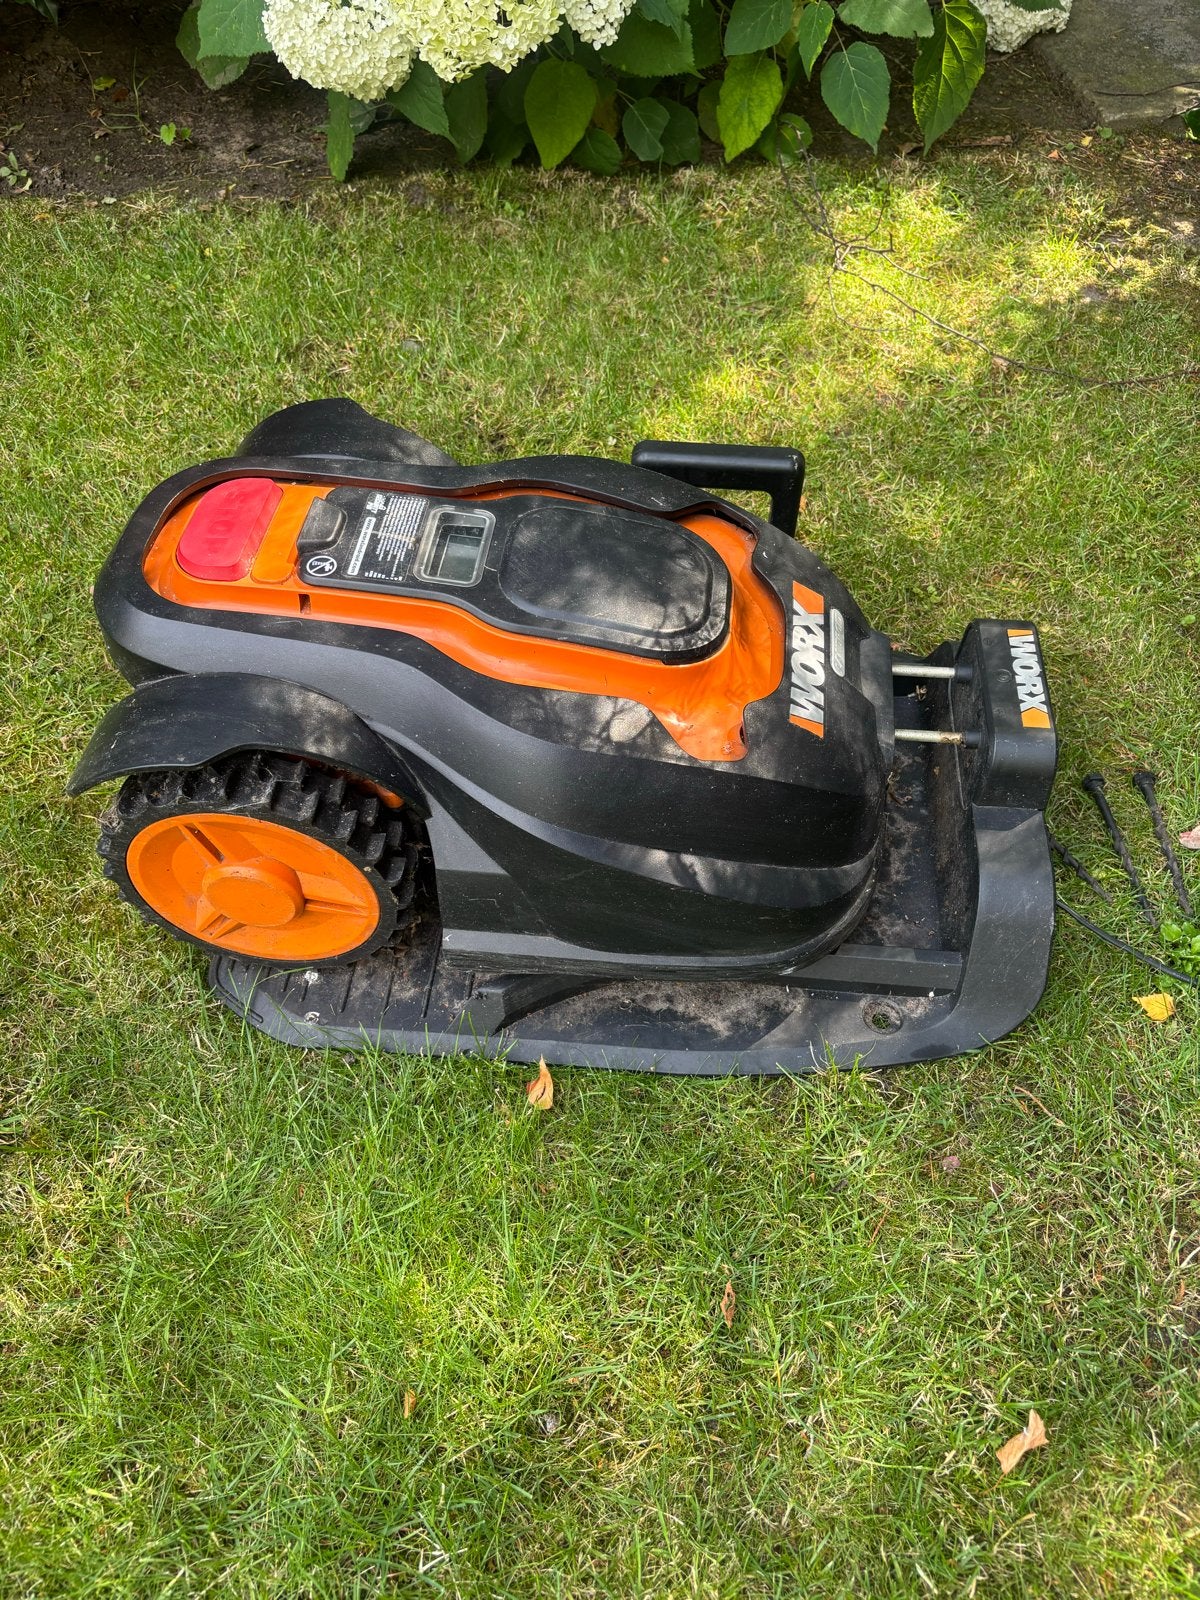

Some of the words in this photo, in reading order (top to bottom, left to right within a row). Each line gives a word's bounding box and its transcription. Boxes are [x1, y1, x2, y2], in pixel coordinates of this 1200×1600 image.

[203, 487, 250, 554] STOP
[790, 599, 826, 723] WORX
[1007, 634, 1048, 713] WORX
